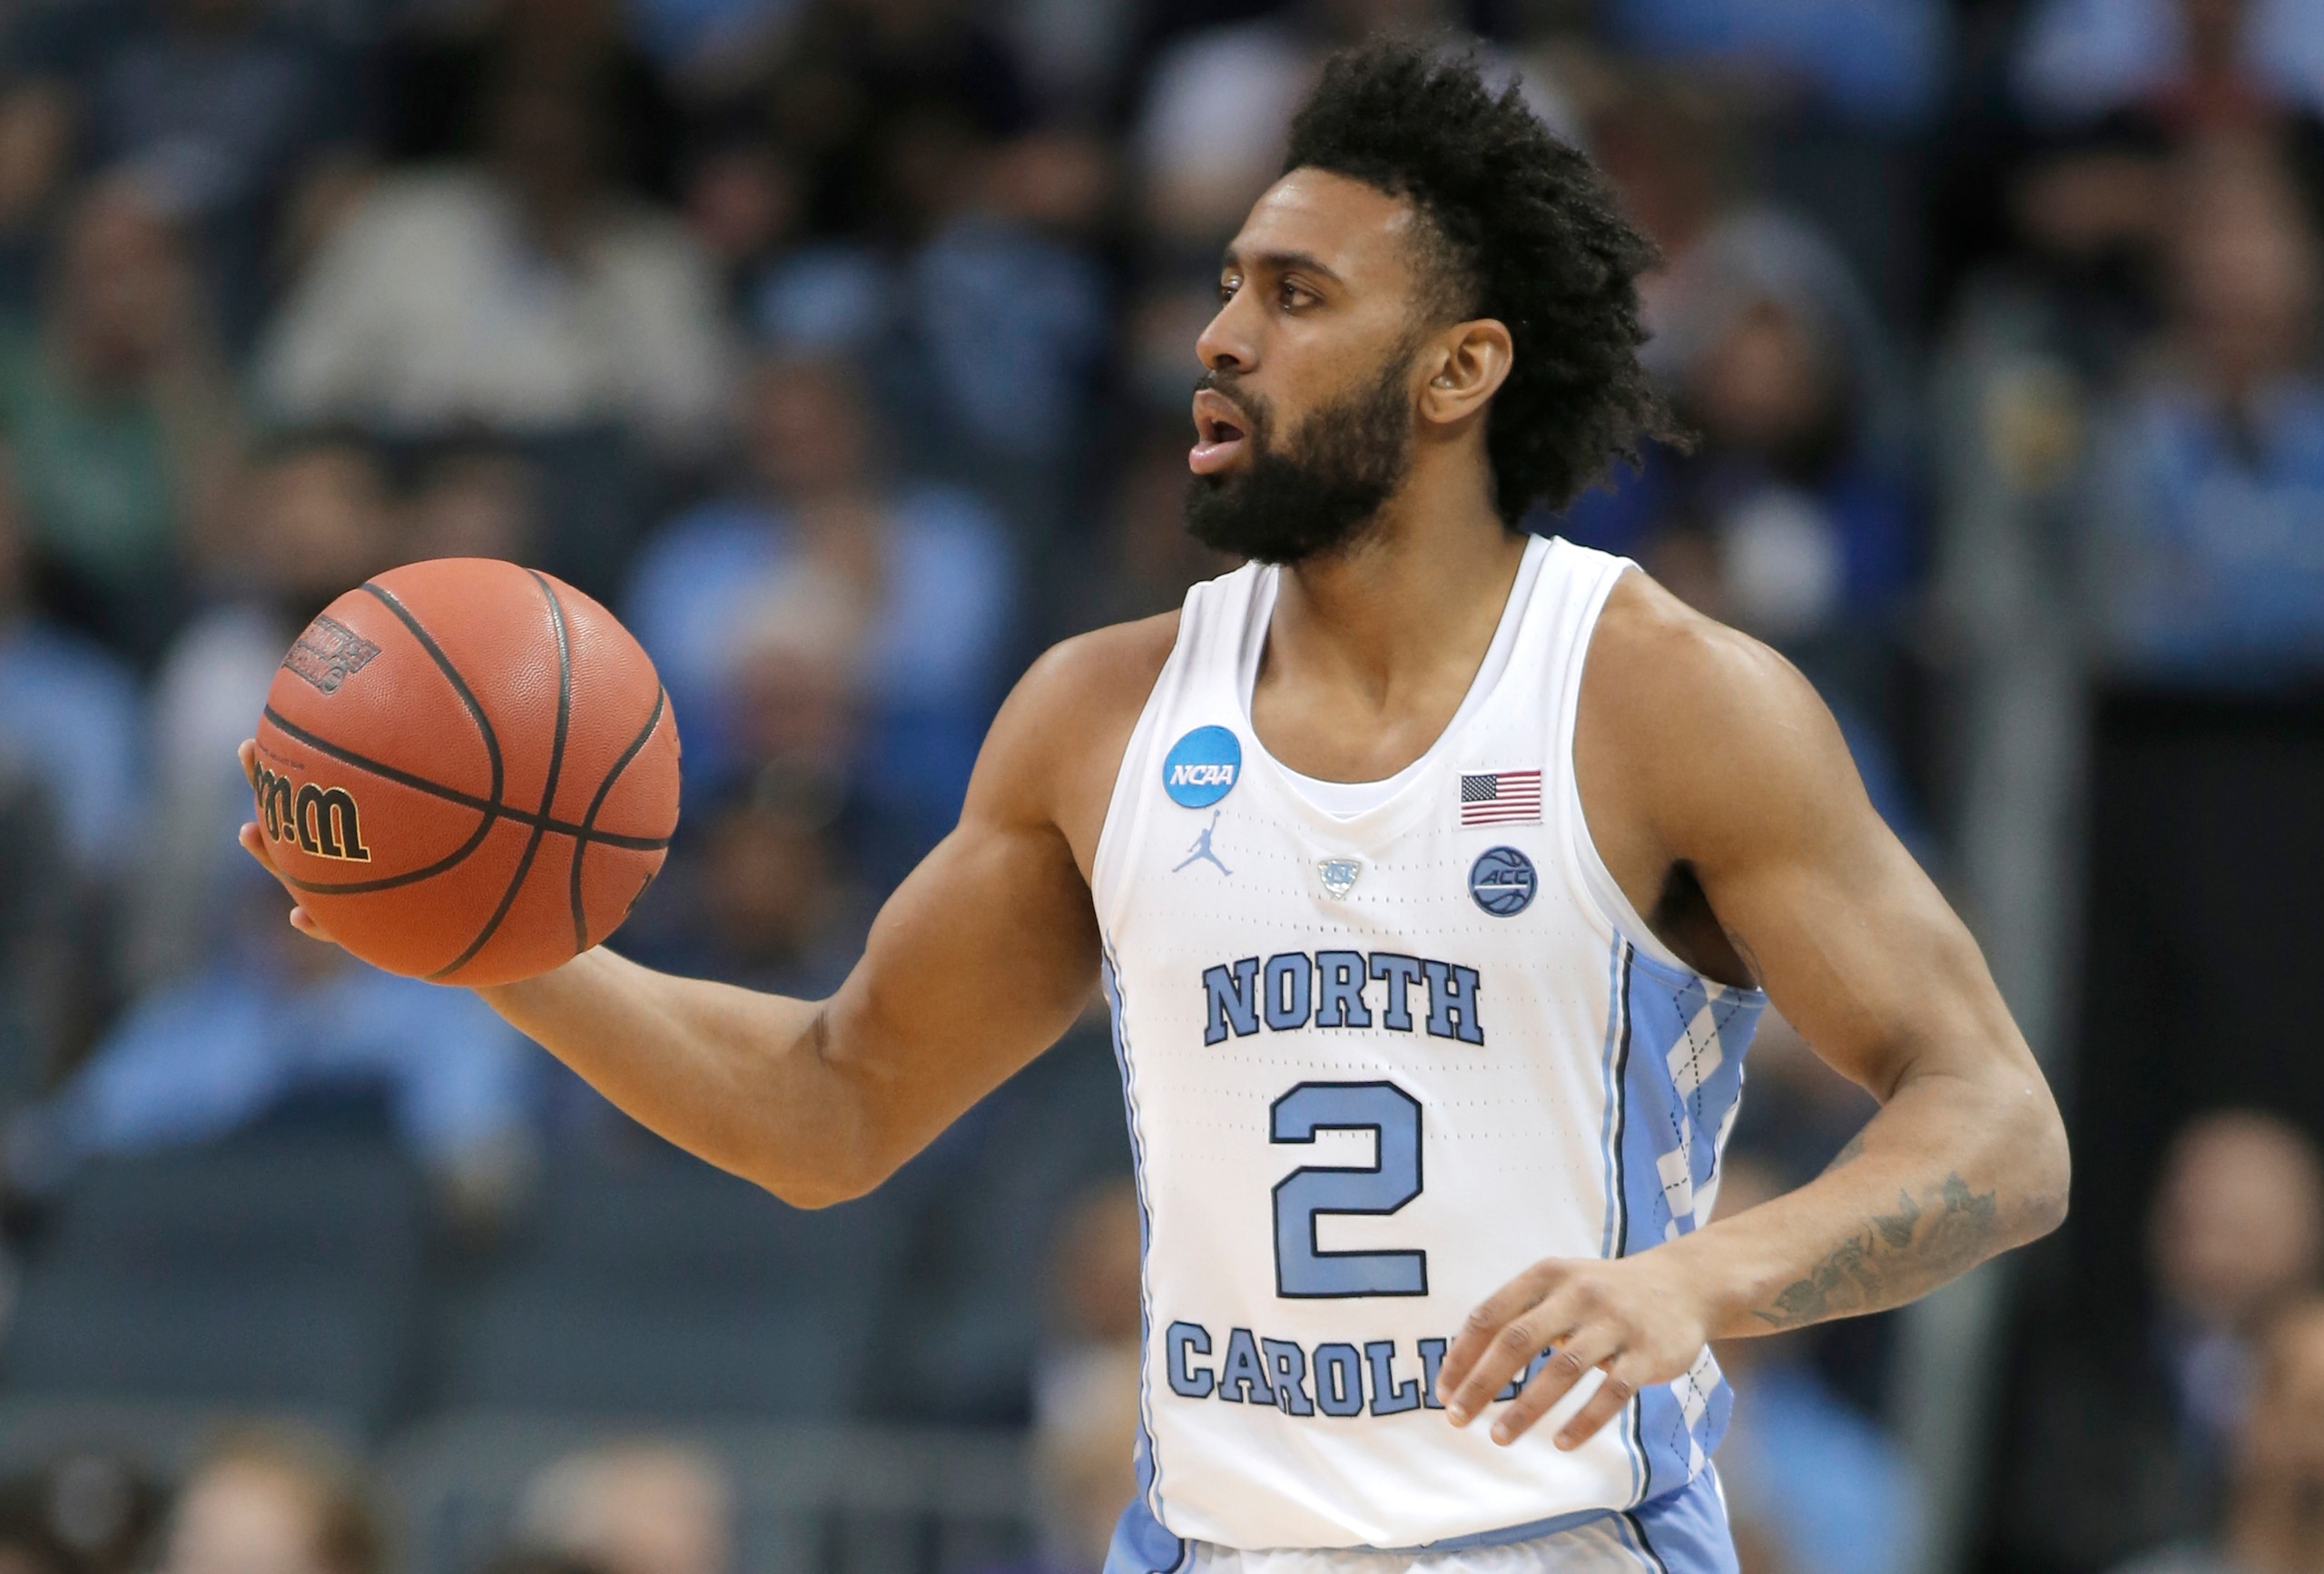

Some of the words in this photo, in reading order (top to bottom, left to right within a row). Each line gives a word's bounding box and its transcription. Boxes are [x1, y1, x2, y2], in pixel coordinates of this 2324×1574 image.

[1169, 763, 1234, 786] NCAA
[1480, 869, 1530, 885] ACC
[1202, 950, 1485, 1047] NORTH
[1269, 1080, 1428, 1298] 2
[1166, 1320, 1555, 1417] CAROLI
